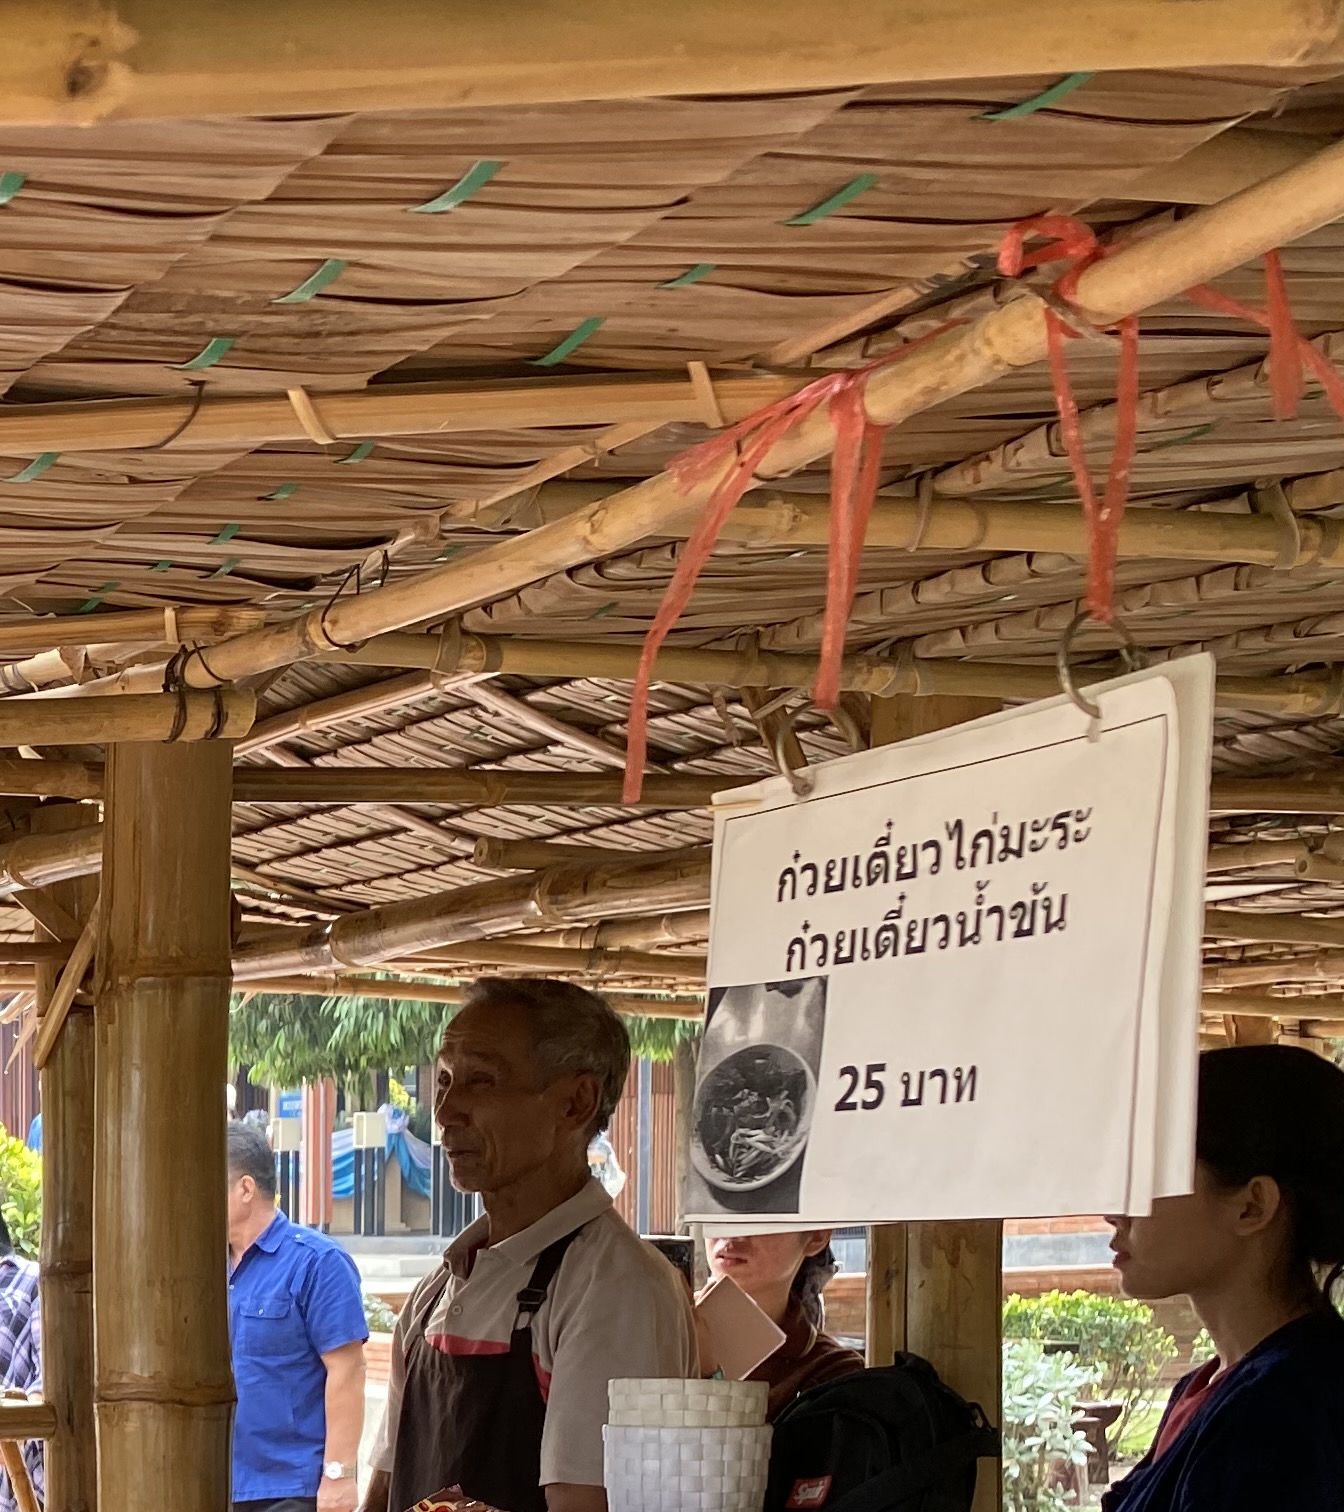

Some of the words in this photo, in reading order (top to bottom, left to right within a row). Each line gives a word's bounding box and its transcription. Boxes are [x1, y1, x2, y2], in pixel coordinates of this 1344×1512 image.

[777, 806, 1092, 902] ก๋วยเตี๋ยวไก่มะระ
[785, 880, 1068, 973] ก๋วยเตี๋ยวน้ำข้น
[834, 1062, 887, 1111] 25
[900, 1063, 978, 1107] บาท
